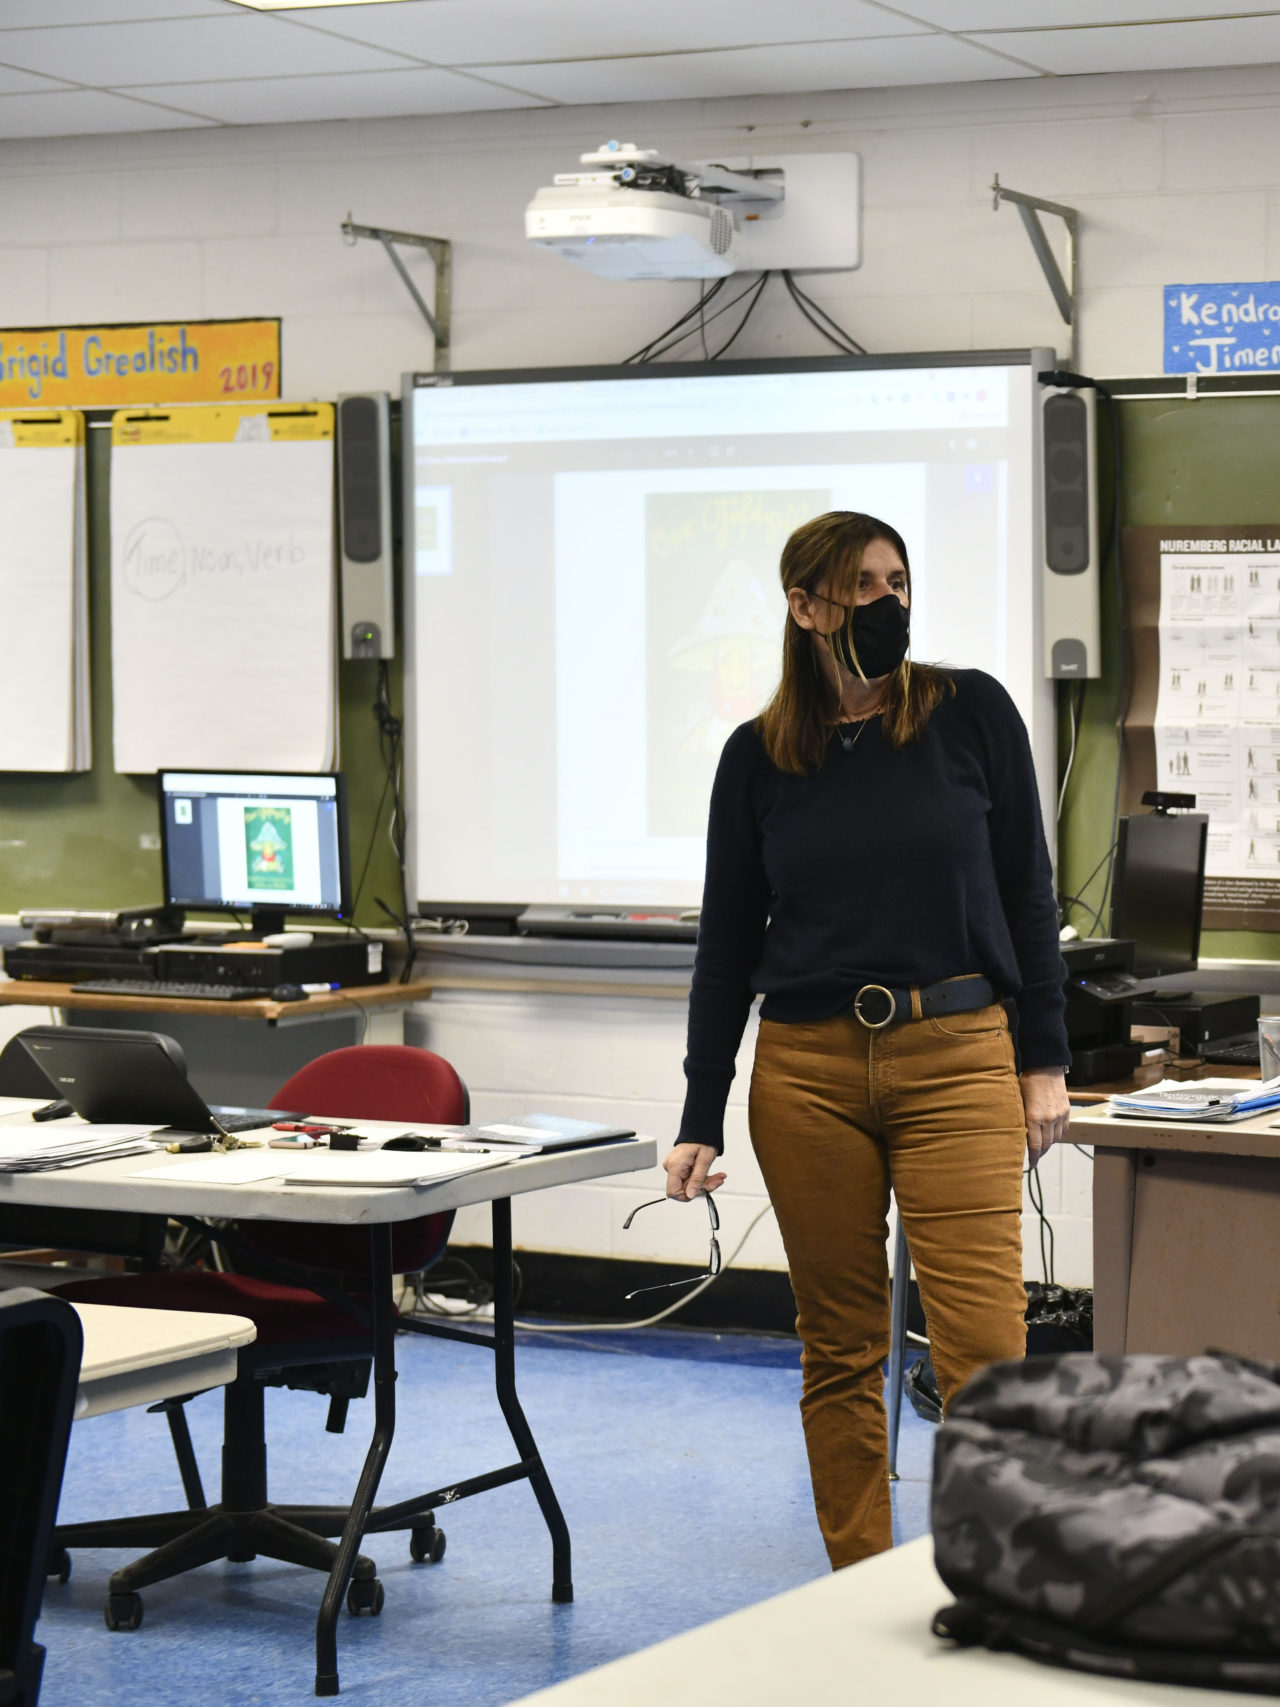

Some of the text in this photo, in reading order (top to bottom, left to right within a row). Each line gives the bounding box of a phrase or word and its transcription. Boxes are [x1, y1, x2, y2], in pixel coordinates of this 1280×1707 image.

[83, 328, 198, 377] Grealish
[219, 361, 275, 393] 2019
[1160, 539, 1227, 552] NUREMBERG
[1228, 539, 1266, 552] RACIAL
